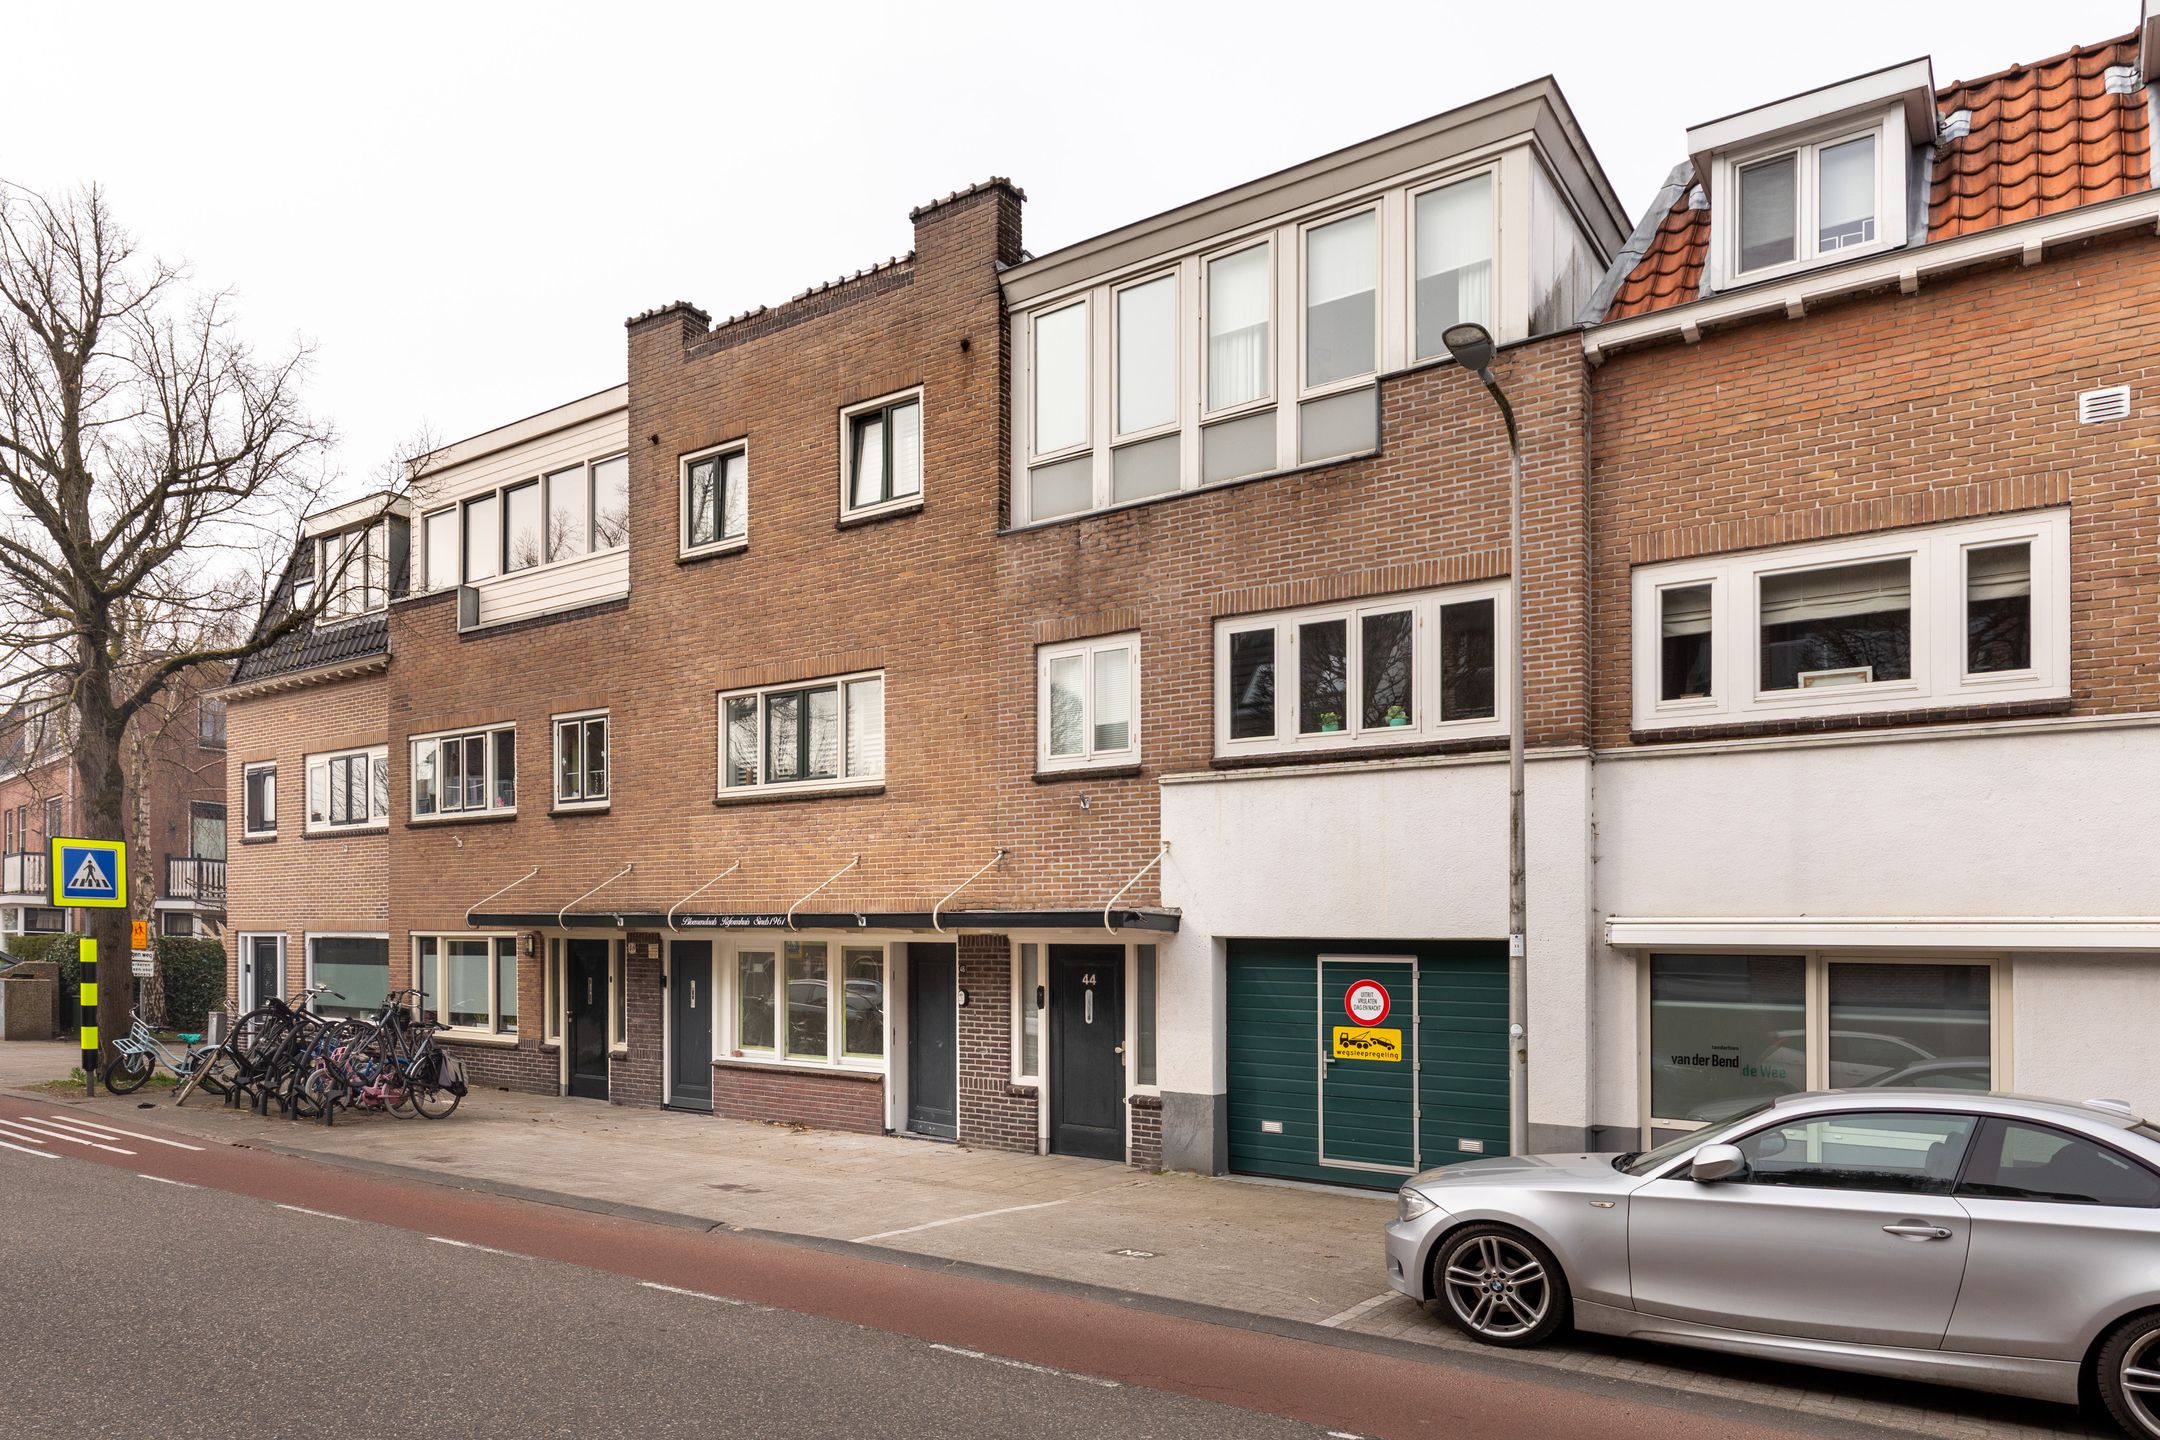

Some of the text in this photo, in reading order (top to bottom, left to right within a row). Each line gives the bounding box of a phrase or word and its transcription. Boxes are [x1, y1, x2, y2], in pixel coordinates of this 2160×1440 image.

[769, 916, 786, 926] 1961
[1082, 973, 1097, 986] 44
[1336, 1050, 1399, 1060] wegsleepregeling
[1671, 1053, 1739, 1068] van der Bend
[1742, 1064, 1757, 1077] de
